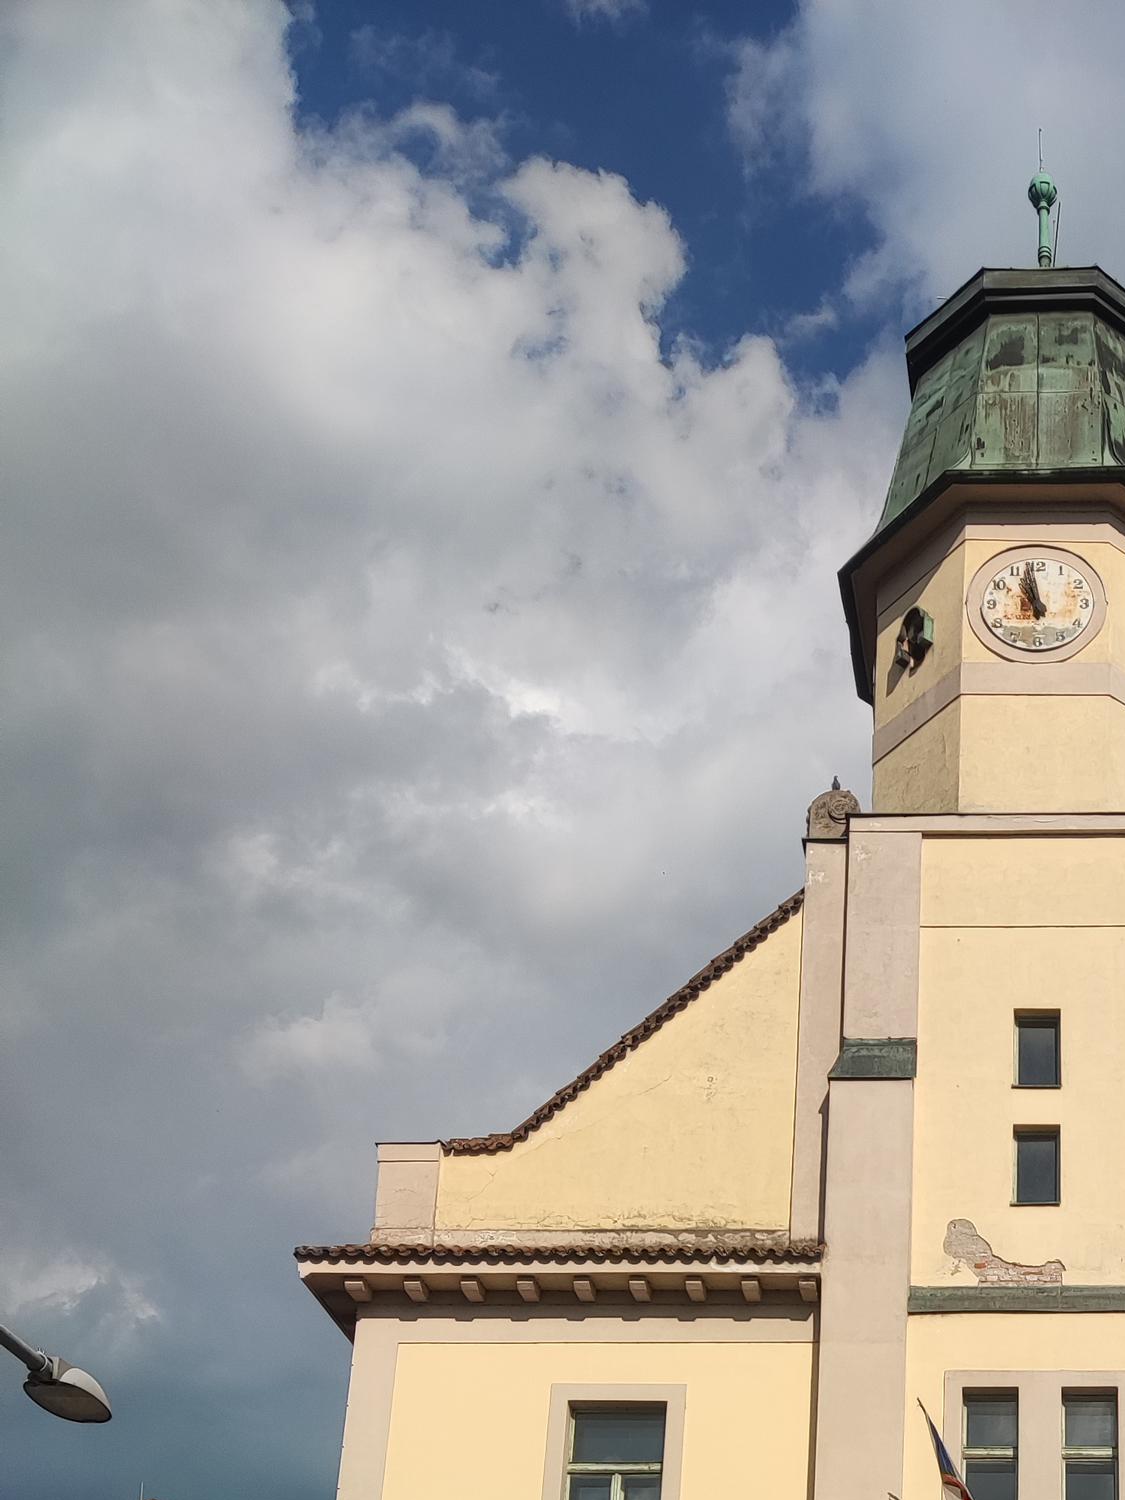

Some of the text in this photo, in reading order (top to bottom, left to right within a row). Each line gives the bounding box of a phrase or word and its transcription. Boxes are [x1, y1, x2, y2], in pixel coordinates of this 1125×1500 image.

[1009, 565, 1020, 577] 11
[992, 578, 1006, 591] 10
[1073, 578, 1084, 590] 2
[986, 599, 997, 610] 9
[1079, 598, 1090, 610] 3
[991, 617, 1003, 629] 8
[1072, 617, 1082, 628] 4
[1033, 636, 1043, 648] 6
[1056, 631, 1066, 642] 5
